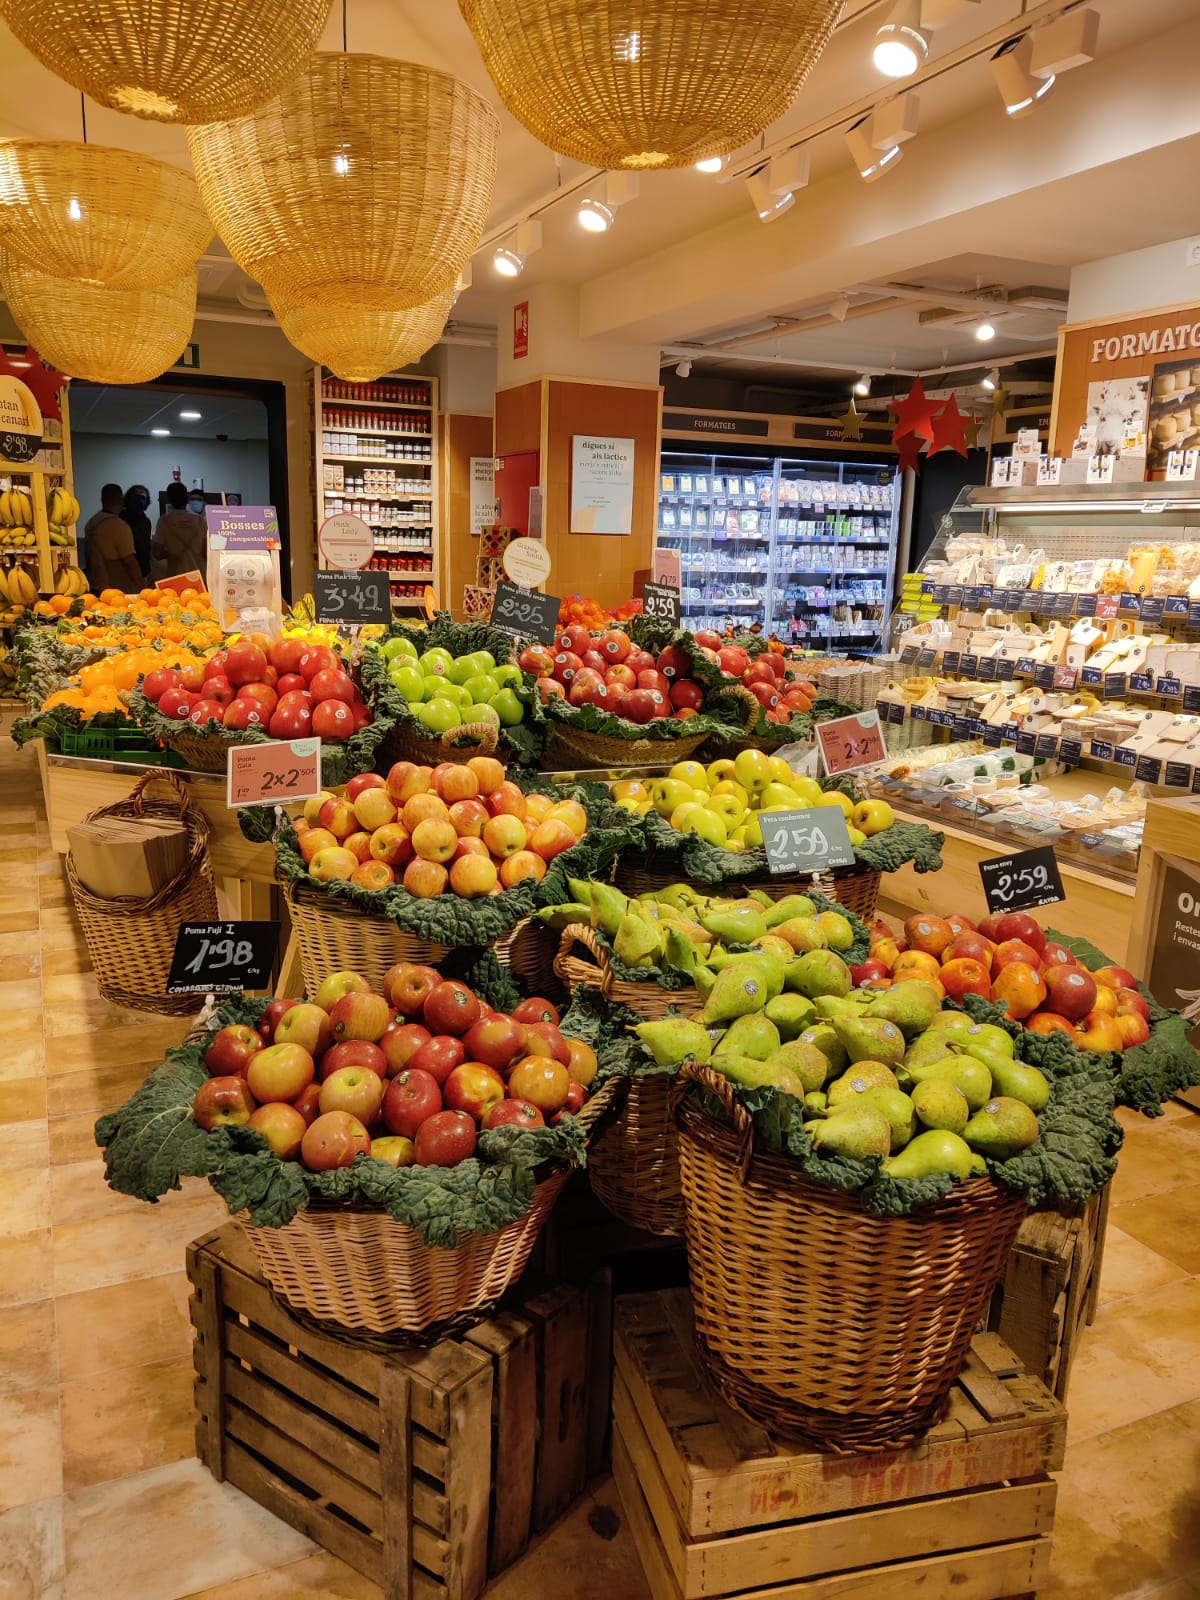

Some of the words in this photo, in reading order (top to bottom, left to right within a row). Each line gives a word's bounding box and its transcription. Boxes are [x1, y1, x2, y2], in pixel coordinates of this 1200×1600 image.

[694, 419, 737, 431] FORMATGES
[582, 441, 607, 450] digues
[592, 452, 603, 460] als
[220, 520, 265, 530] Bosses
[990, 865, 1048, 902] 2'59
[184, 927, 206, 935] Poma
[206, 926, 223, 935] Fuji
[184, 939, 254, 974] 1'98
